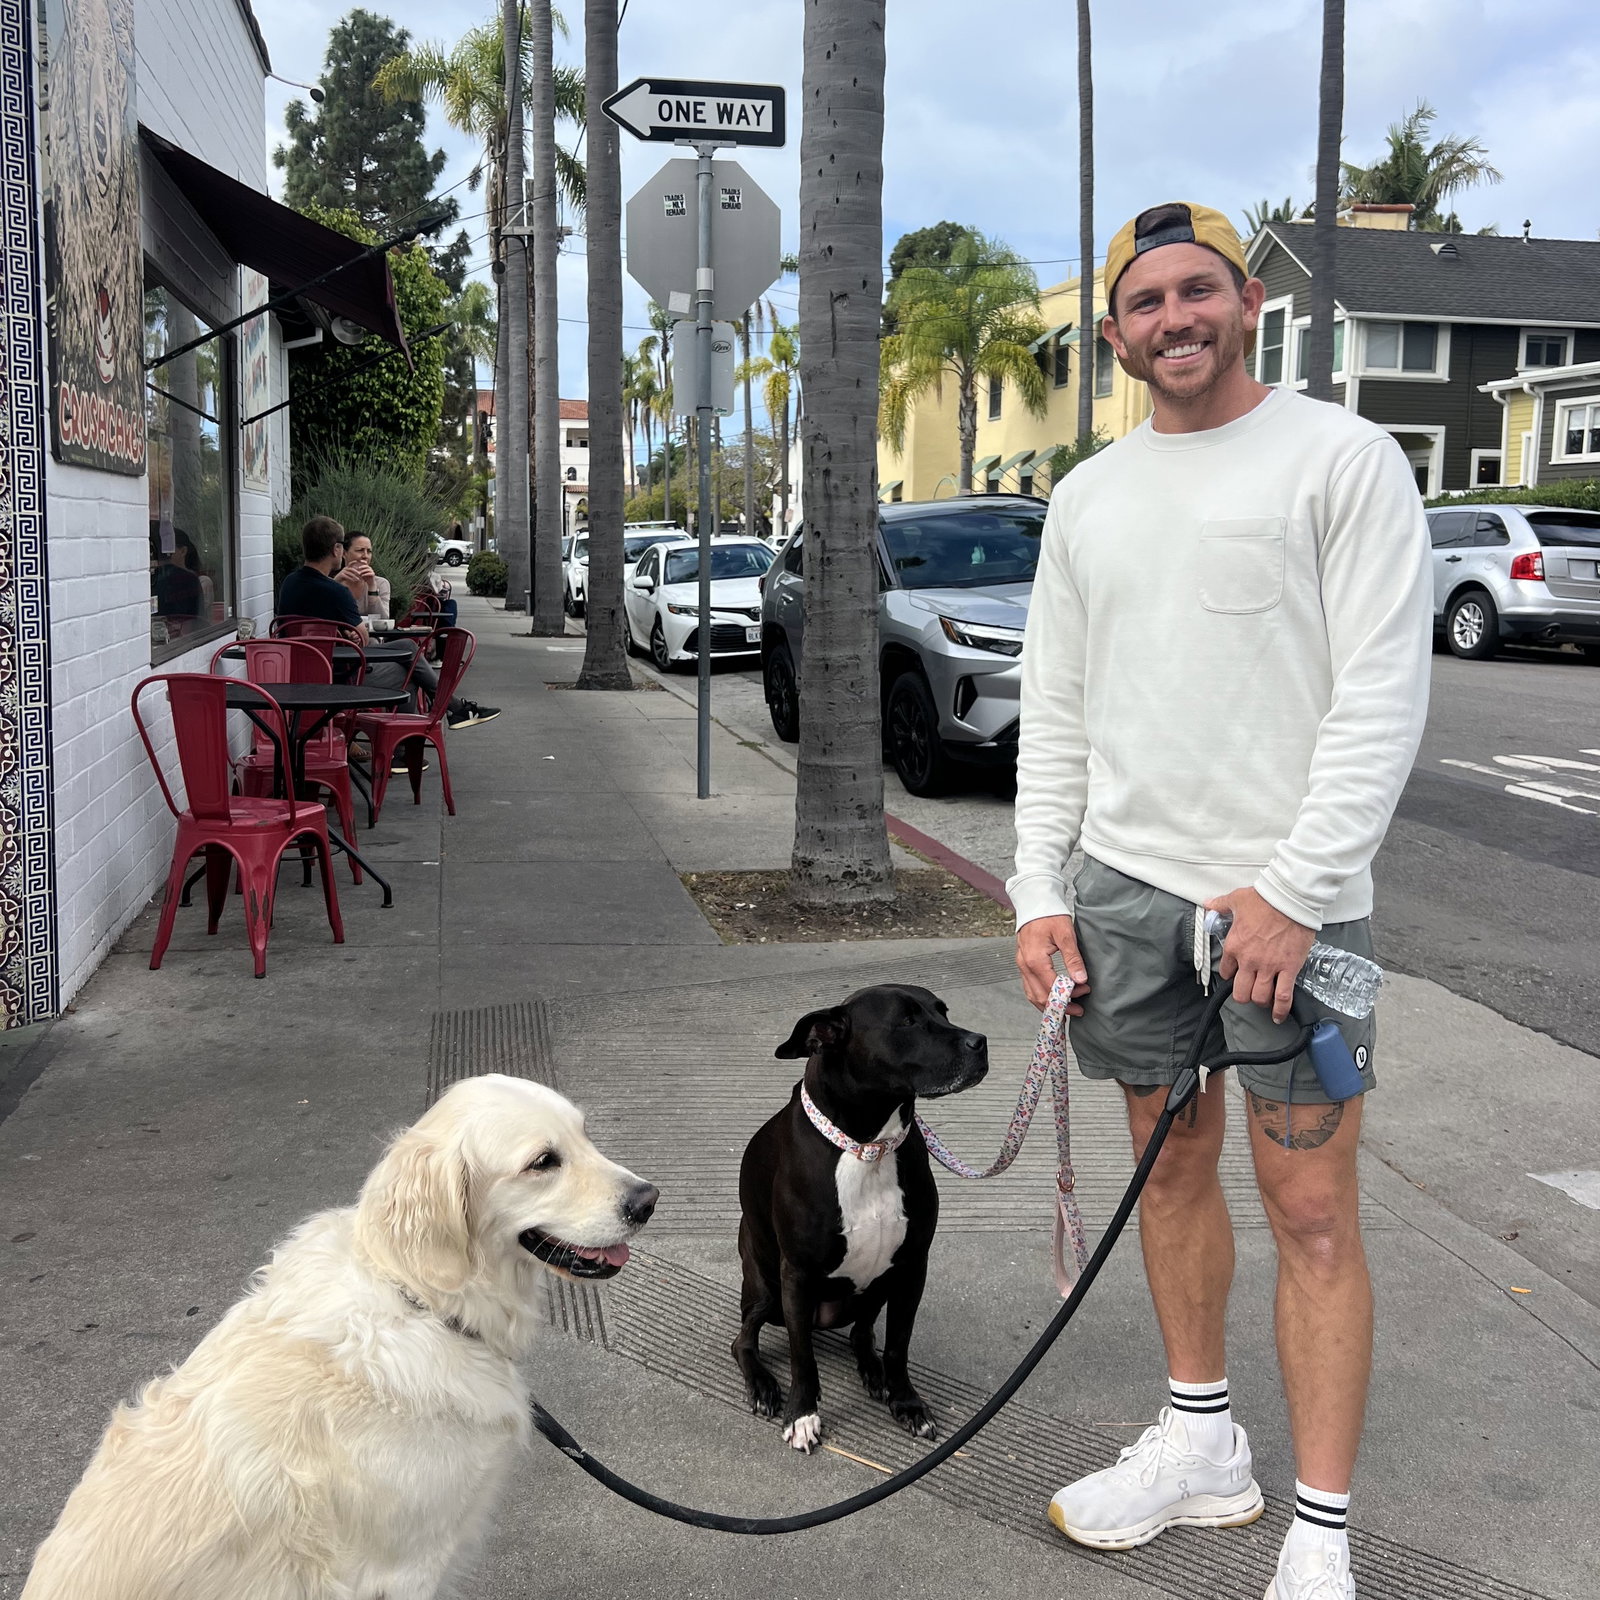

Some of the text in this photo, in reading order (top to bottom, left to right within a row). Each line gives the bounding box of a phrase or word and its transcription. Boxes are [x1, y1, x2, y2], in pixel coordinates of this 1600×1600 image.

[658, 99, 766, 126] ONE WAY
[59, 380, 145, 464] CRUSHCAKES
